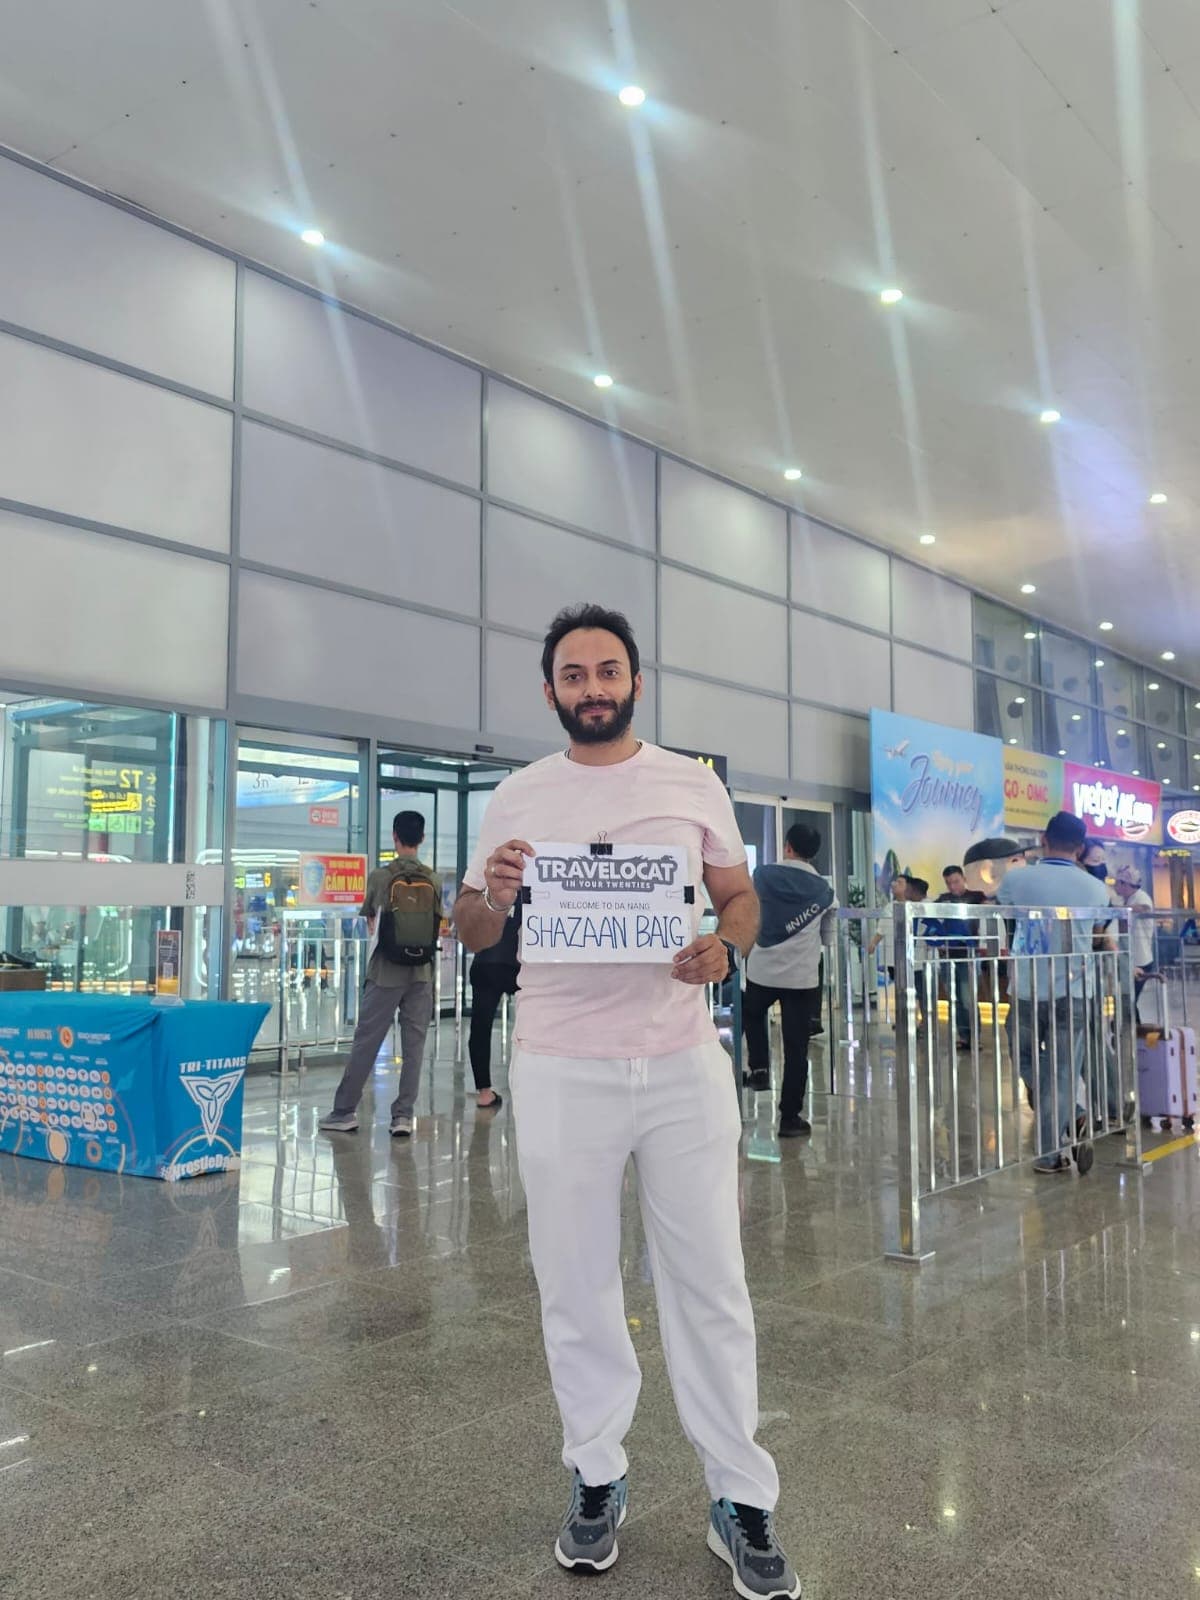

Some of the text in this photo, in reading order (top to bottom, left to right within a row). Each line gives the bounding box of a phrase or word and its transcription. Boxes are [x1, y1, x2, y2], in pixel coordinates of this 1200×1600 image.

[902, 752, 982, 832] Journey
[538, 859, 674, 882] TRAVELOCAT
[579, 880, 603, 889] YOUR
[606, 881, 651, 889] TWENTIES
[560, 901, 650, 910] WELCOME TO DA NANG
[526, 915, 685, 949] SHAZAAN BAIG
[179, 1056, 247, 1074] TRI-TITANS
